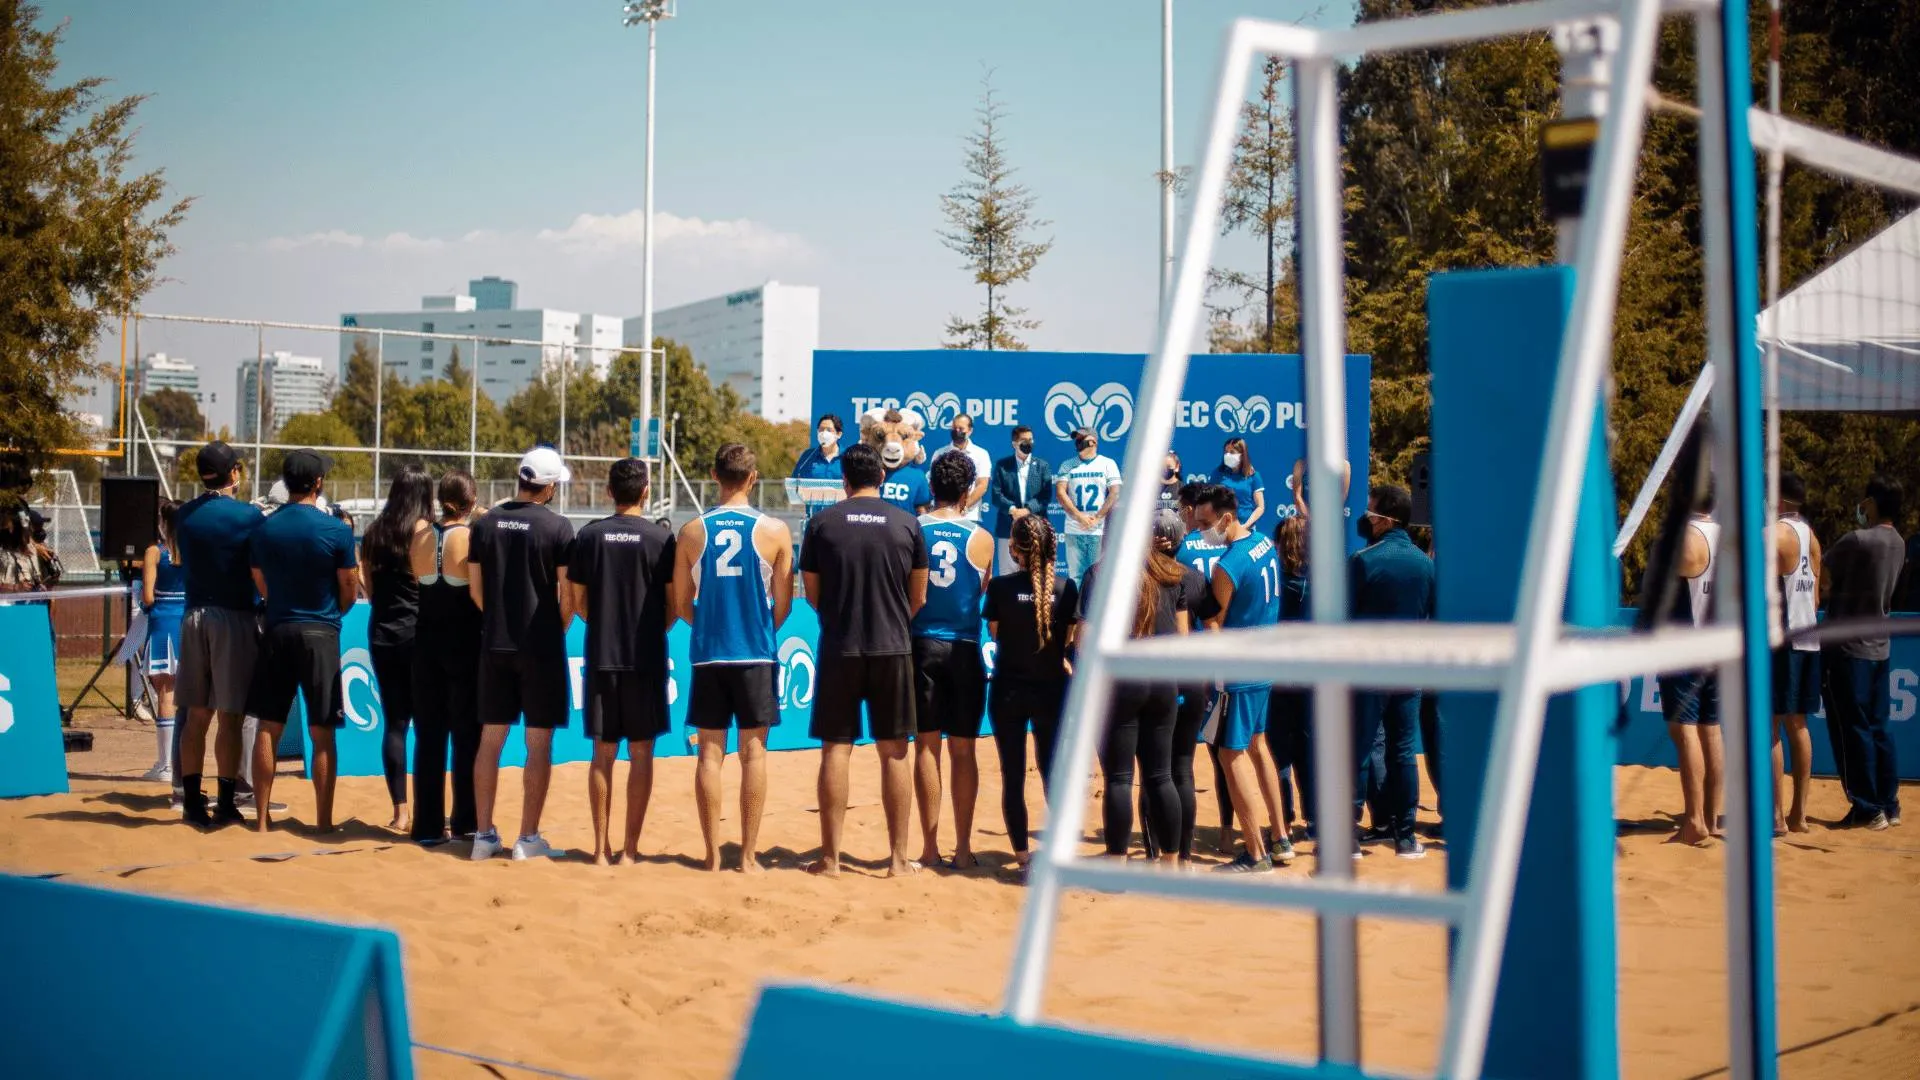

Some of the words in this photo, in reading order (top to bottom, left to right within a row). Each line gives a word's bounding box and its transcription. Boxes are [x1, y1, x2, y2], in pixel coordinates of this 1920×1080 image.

[966, 399, 1019, 426] PUE
[1175, 400, 1210, 428] EC
[882, 482, 910, 501] EC
[1075, 484, 1099, 512] 12
[715, 529, 743, 576] 2
[929, 540, 958, 588] 3
[1801, 556, 1809, 576] 2
[1260, 557, 1280, 604] 11
